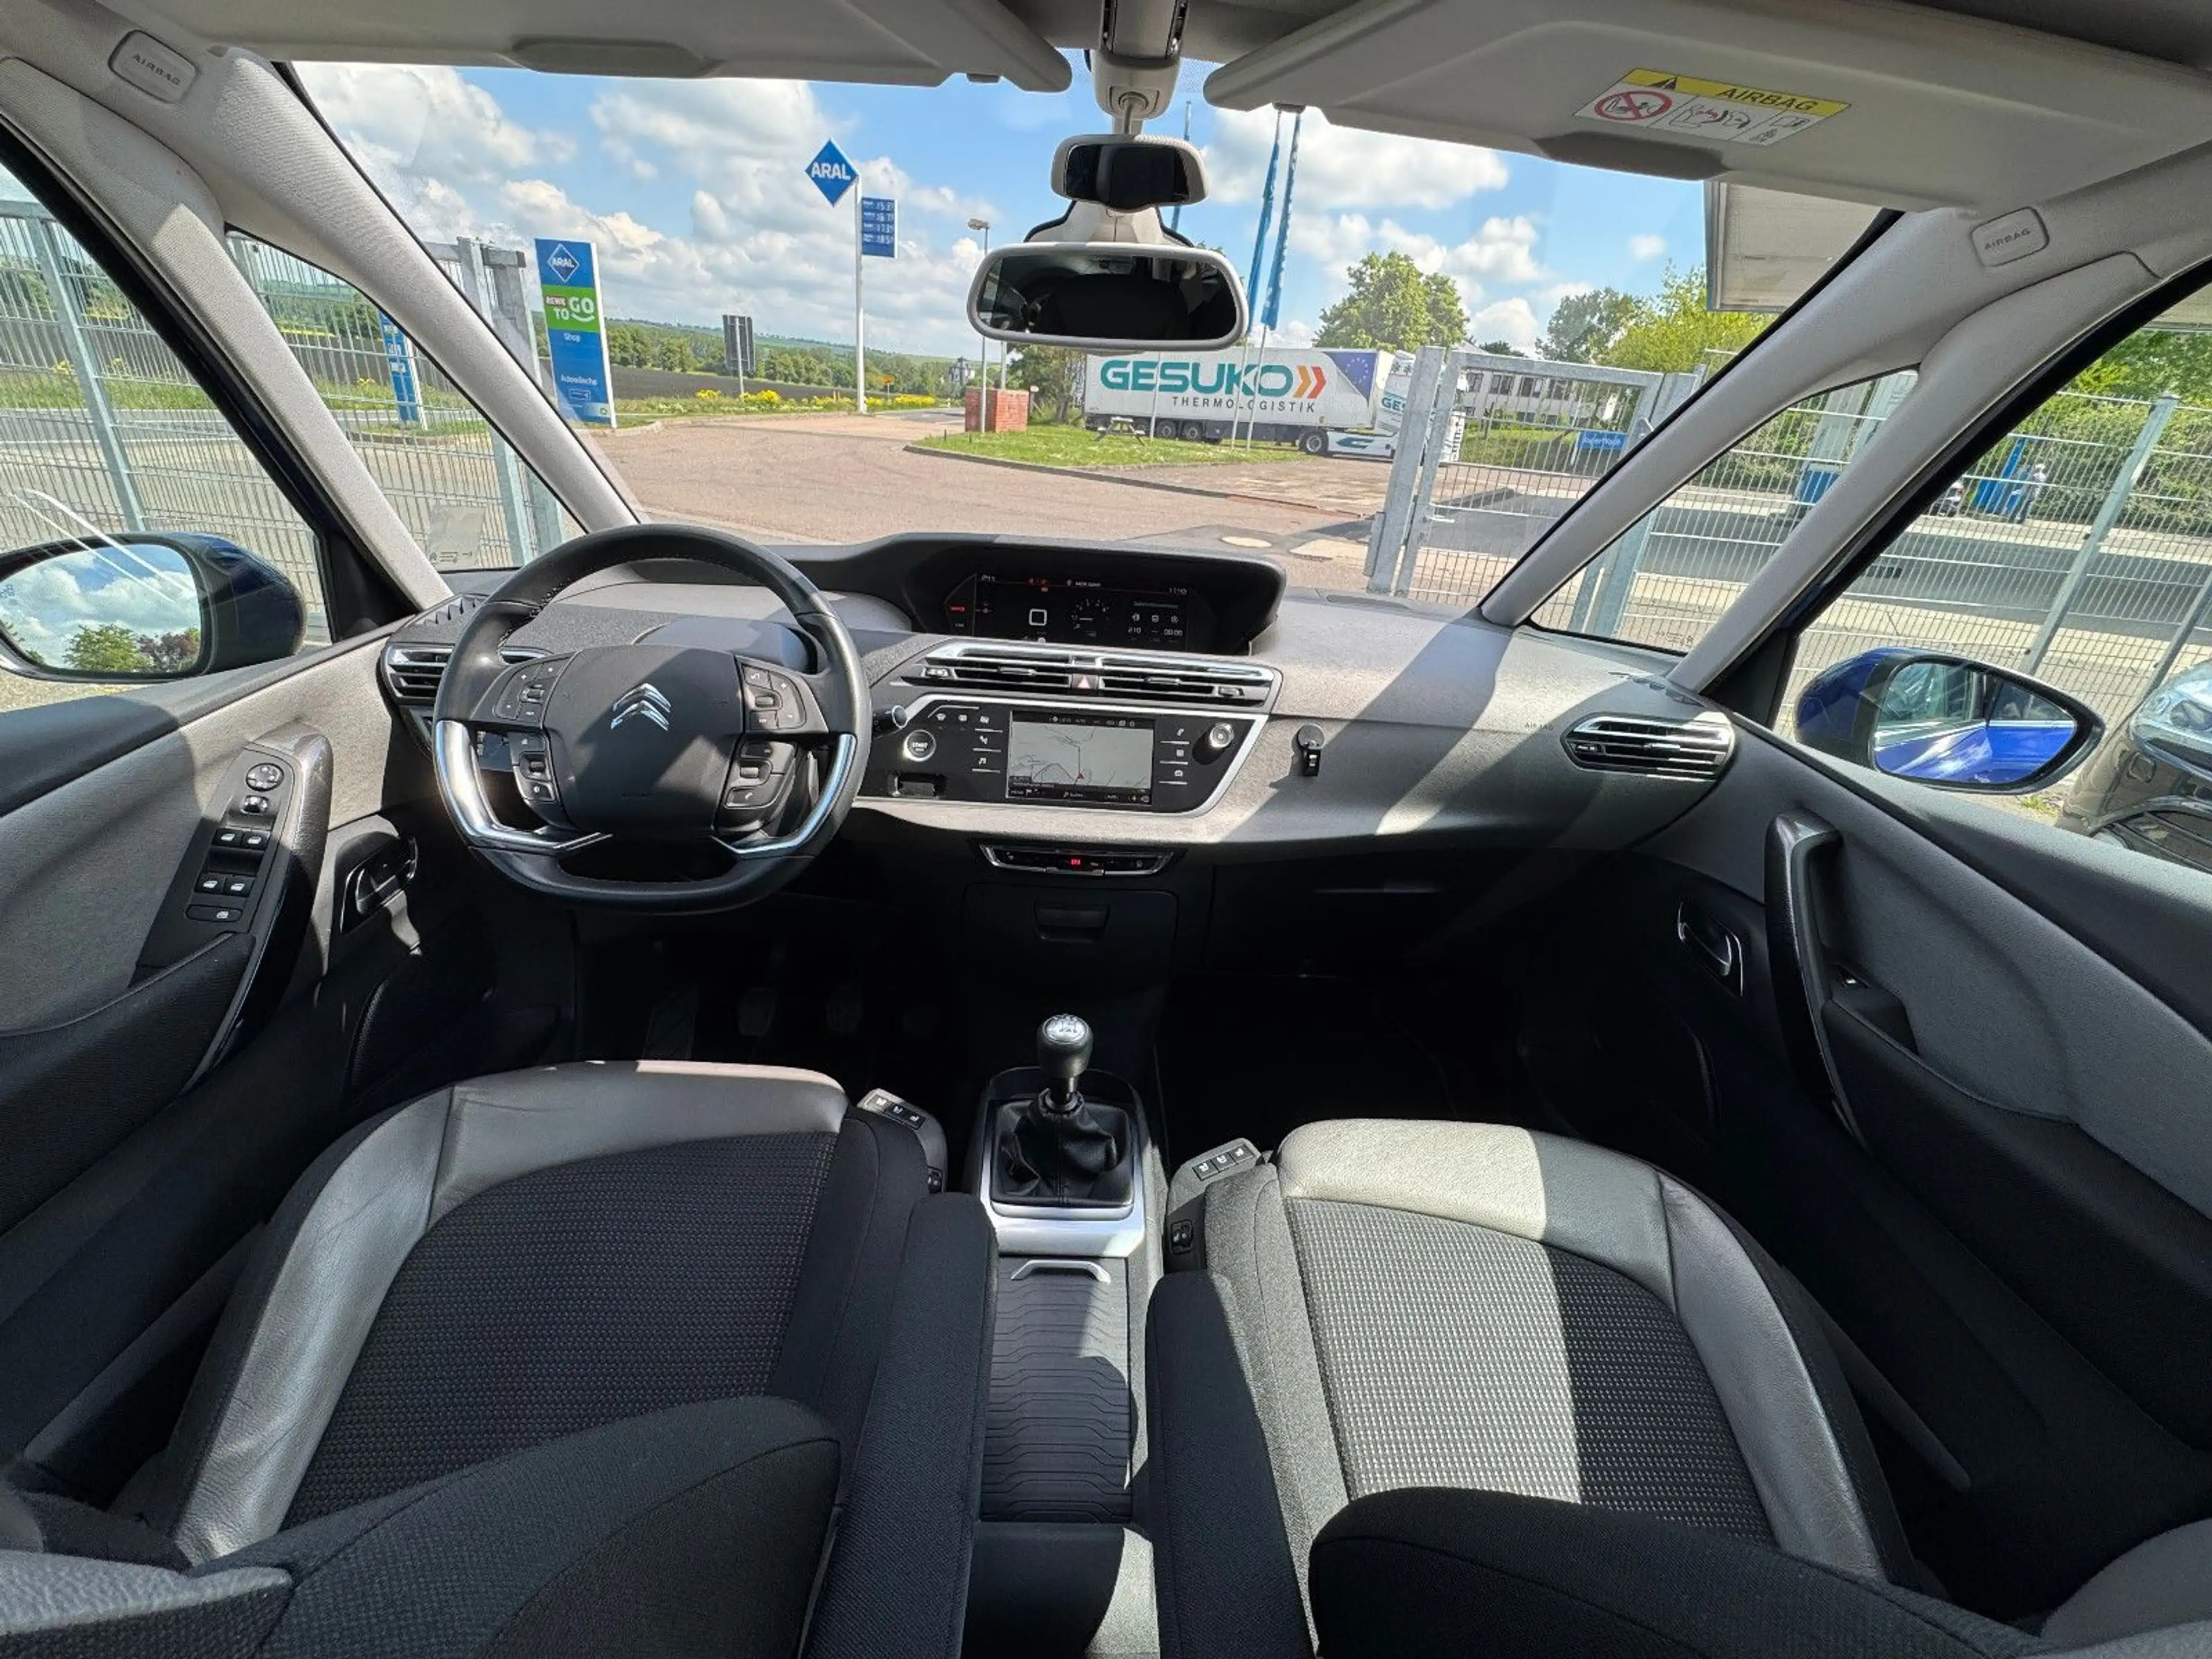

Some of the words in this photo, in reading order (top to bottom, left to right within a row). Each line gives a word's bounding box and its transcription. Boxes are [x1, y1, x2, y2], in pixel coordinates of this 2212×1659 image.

[133, 55, 181, 85] AIRBAG
[1716, 88, 1818, 111] AIRBAG
[811, 162, 851, 180] ARAL
[1984, 229, 2031, 250] AIRBAG
[551, 257, 574, 268] ARAL
[553, 308, 569, 320] TO
[569, 296, 595, 314] GO
[1100, 359, 1294, 397] GESUKO
[1382, 396, 1407, 414] GE
